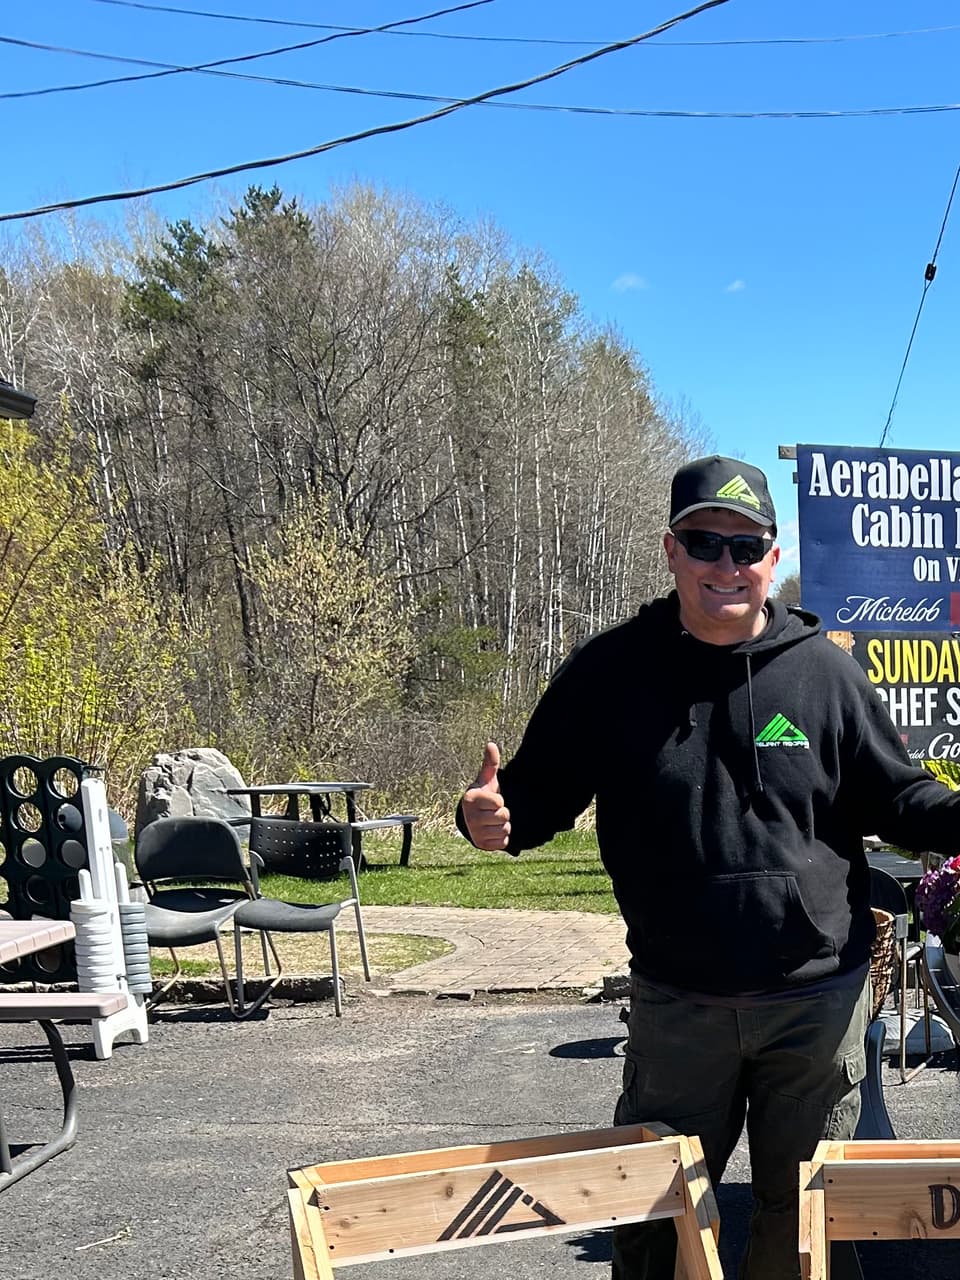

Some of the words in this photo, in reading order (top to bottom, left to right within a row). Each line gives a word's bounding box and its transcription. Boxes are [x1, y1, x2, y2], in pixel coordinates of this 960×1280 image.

[852, 503, 944, 549] Cabin
[913, 556, 940, 582] On
[836, 596, 944, 624] Michelob
